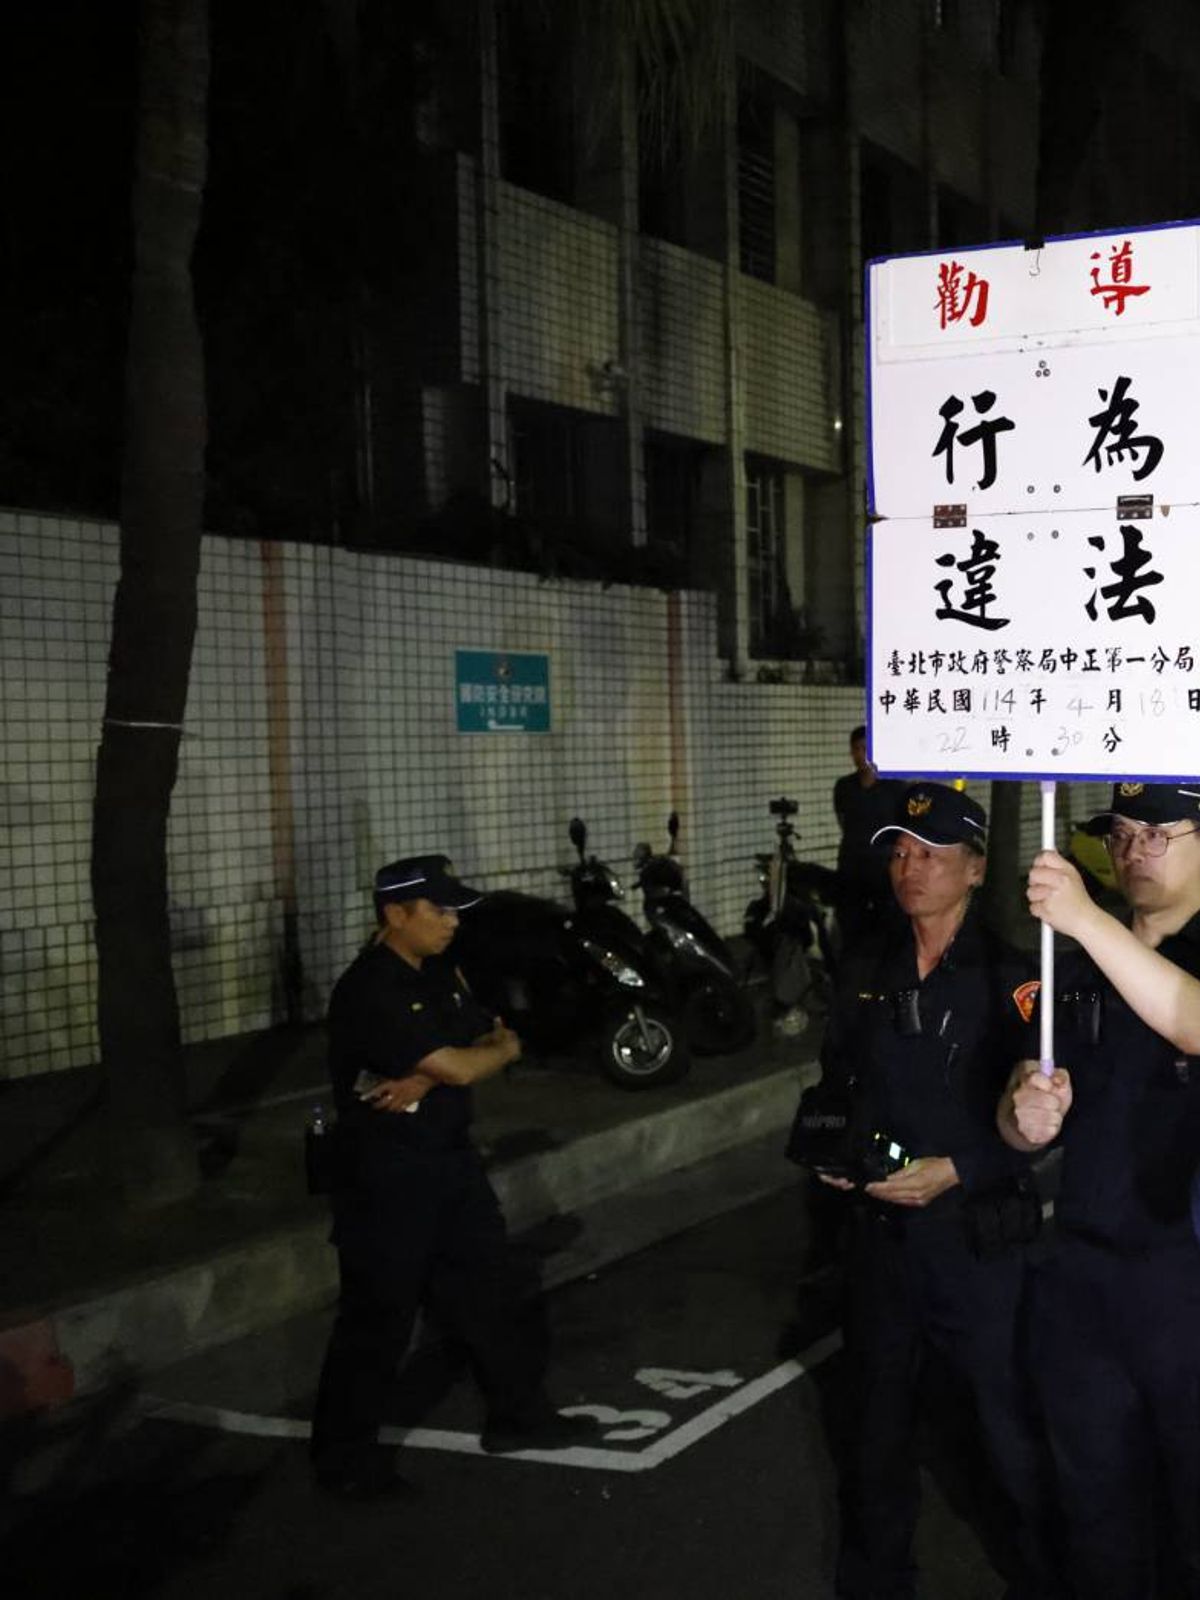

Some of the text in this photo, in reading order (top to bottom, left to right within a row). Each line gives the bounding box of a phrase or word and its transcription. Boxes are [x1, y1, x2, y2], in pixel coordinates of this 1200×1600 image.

[933, 240, 1151, 330] 勸導
[931, 375, 1165, 490] 行為
[933, 524, 1165, 632] 違法
[887, 645, 1195, 677] 臺北市政府警察局中正第一分局
